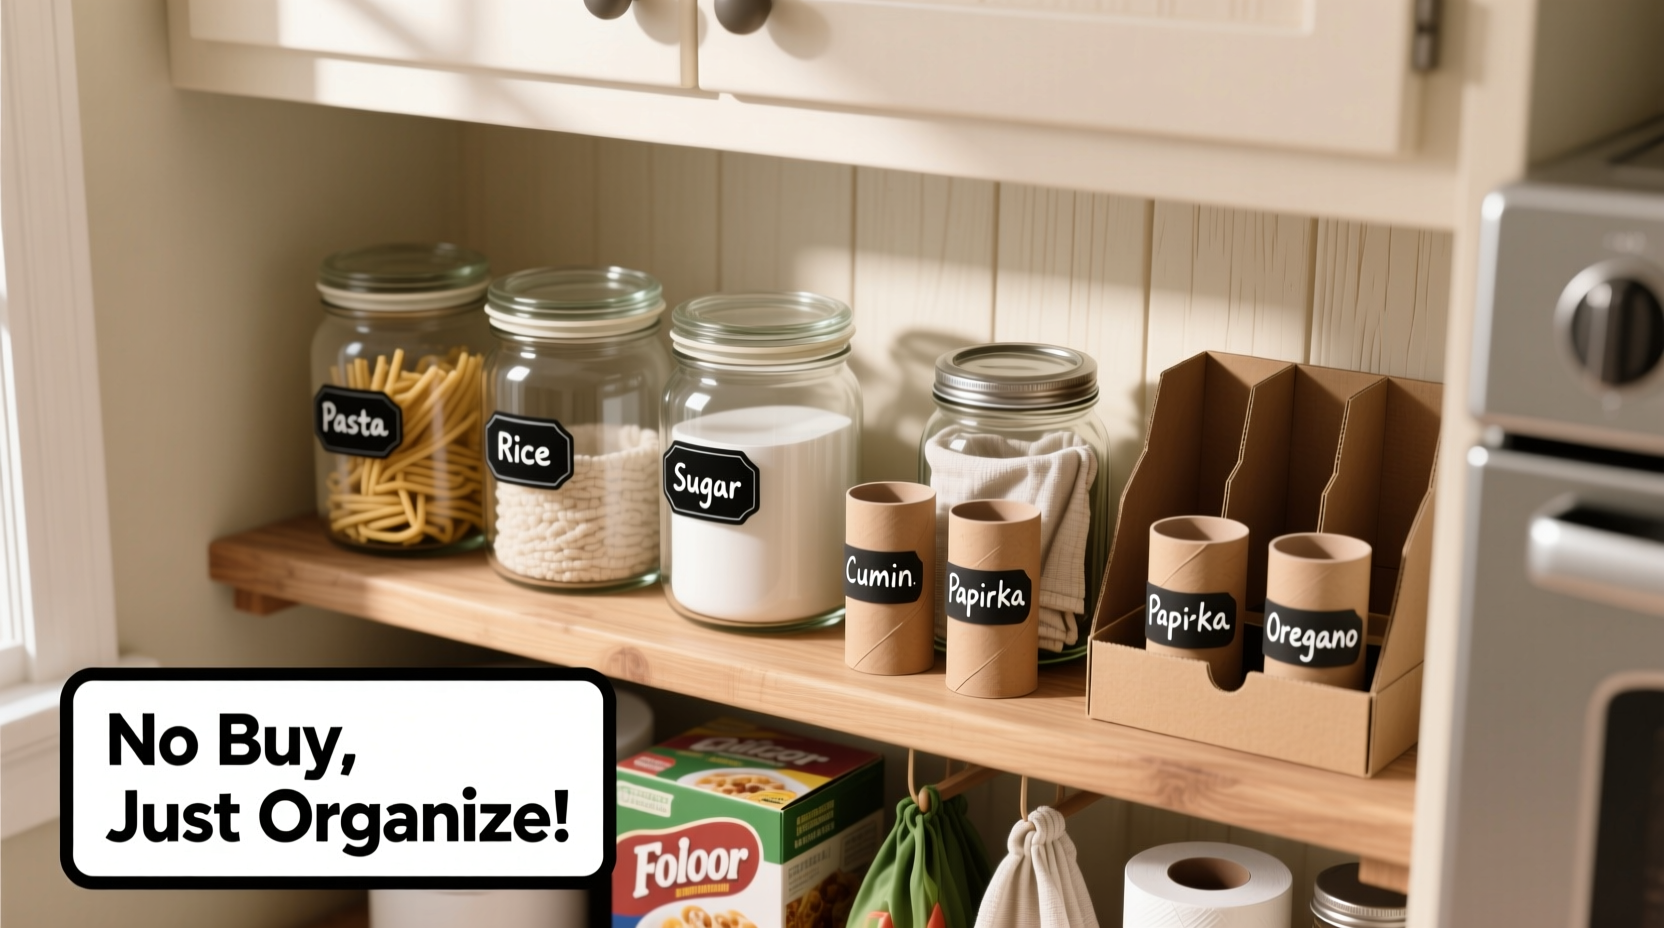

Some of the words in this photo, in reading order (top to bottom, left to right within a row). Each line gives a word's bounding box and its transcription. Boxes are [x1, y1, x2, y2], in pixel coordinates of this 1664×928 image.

[321, 402, 389, 437] Pasta
[497, 431, 551, 467] Rice
[673, 462, 742, 509] Sugar
[948, 572, 1026, 618] Papirka
[1266, 611, 1358, 663] Oregano
[632, 836, 749, 899] Foloor
